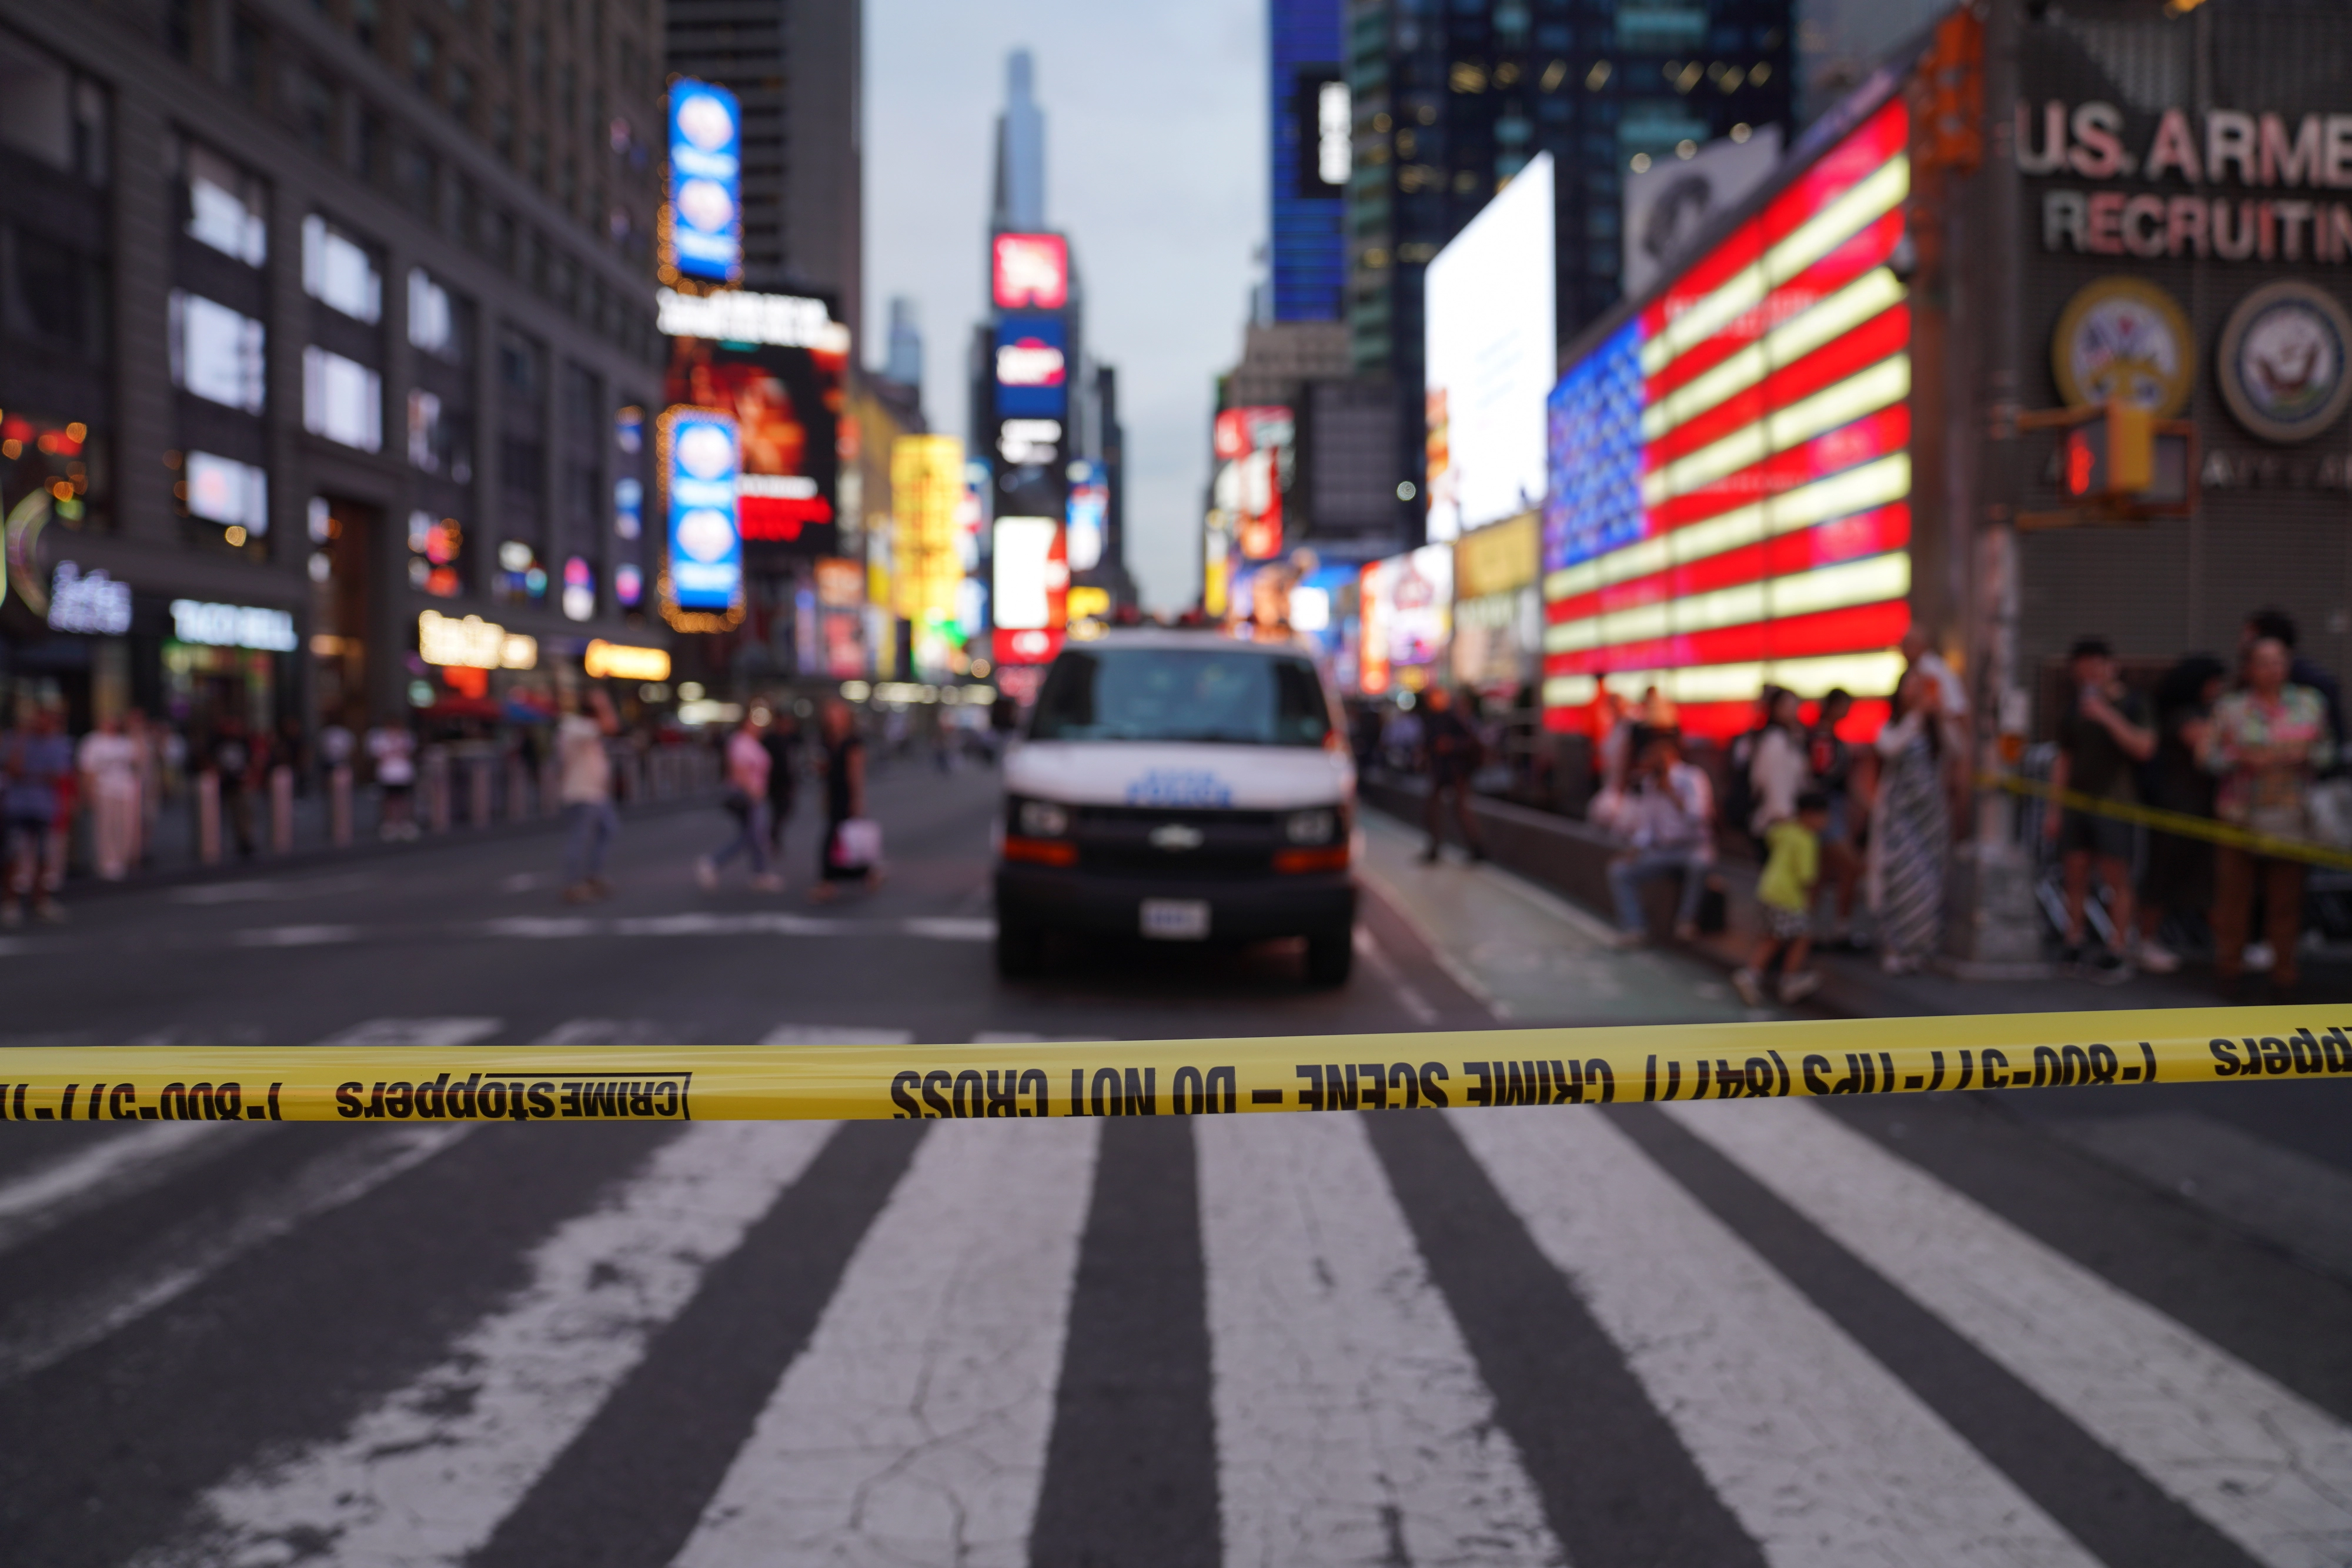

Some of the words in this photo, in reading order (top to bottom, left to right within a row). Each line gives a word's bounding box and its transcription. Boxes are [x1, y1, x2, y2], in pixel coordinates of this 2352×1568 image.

[890, 1069, 1048, 1119] CROSS
[1064, 1067, 1156, 1116] NOT
[1172, 1065, 1236, 1115] DO
[1295, 1061, 1449, 1112] SCENE
[1462, 1058, 1615, 1106] CRIME
